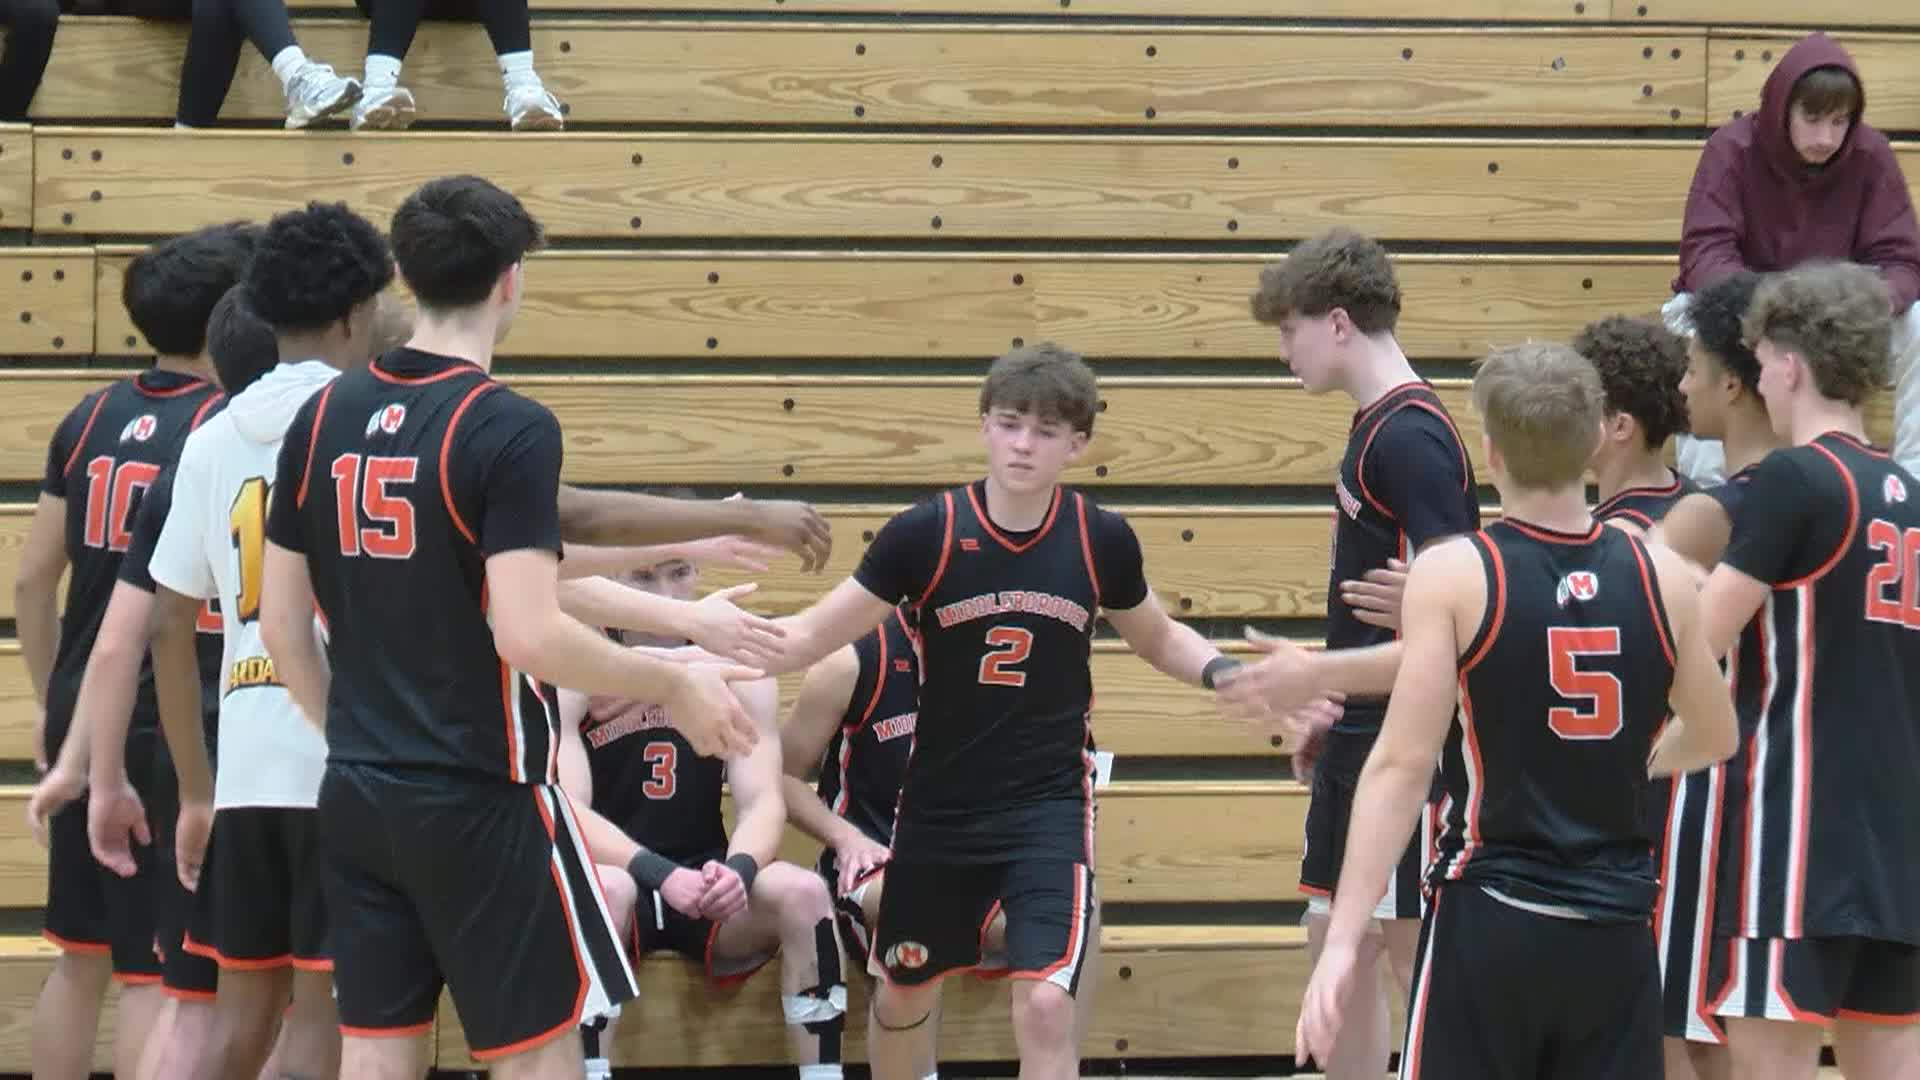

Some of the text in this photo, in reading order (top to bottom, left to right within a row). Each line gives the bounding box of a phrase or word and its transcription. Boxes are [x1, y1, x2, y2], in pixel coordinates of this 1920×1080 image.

[331, 453, 418, 558] 15
[1570, 575, 1594, 595] M
[1865, 519, 1920, 630] 20
[978, 626, 1034, 687] 2
[1547, 626, 1623, 740] 5
[642, 741, 677, 799] 3
